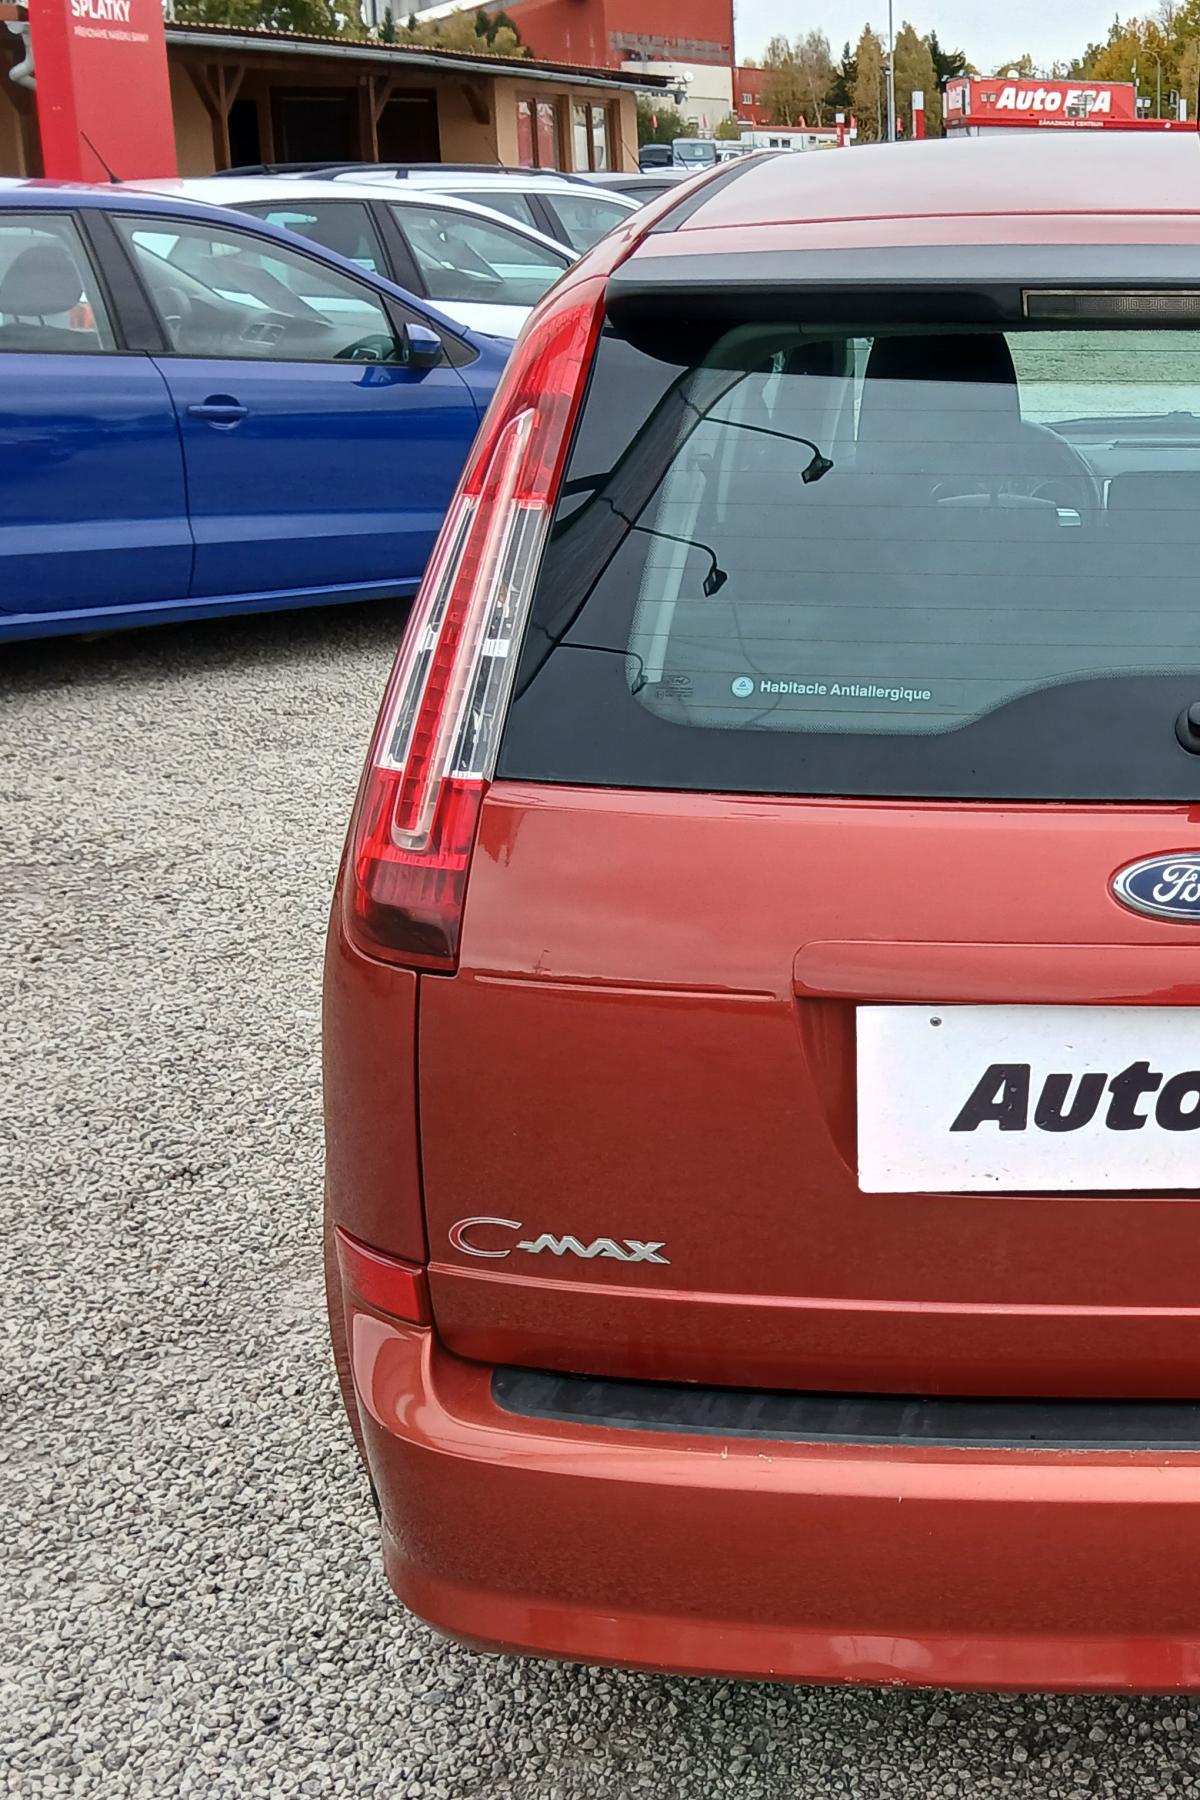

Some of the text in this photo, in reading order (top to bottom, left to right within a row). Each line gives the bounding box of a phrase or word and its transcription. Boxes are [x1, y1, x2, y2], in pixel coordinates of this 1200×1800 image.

[995, 87, 1062, 112] Auto
[760, 680, 932, 702] Habitacle Antiallergique
